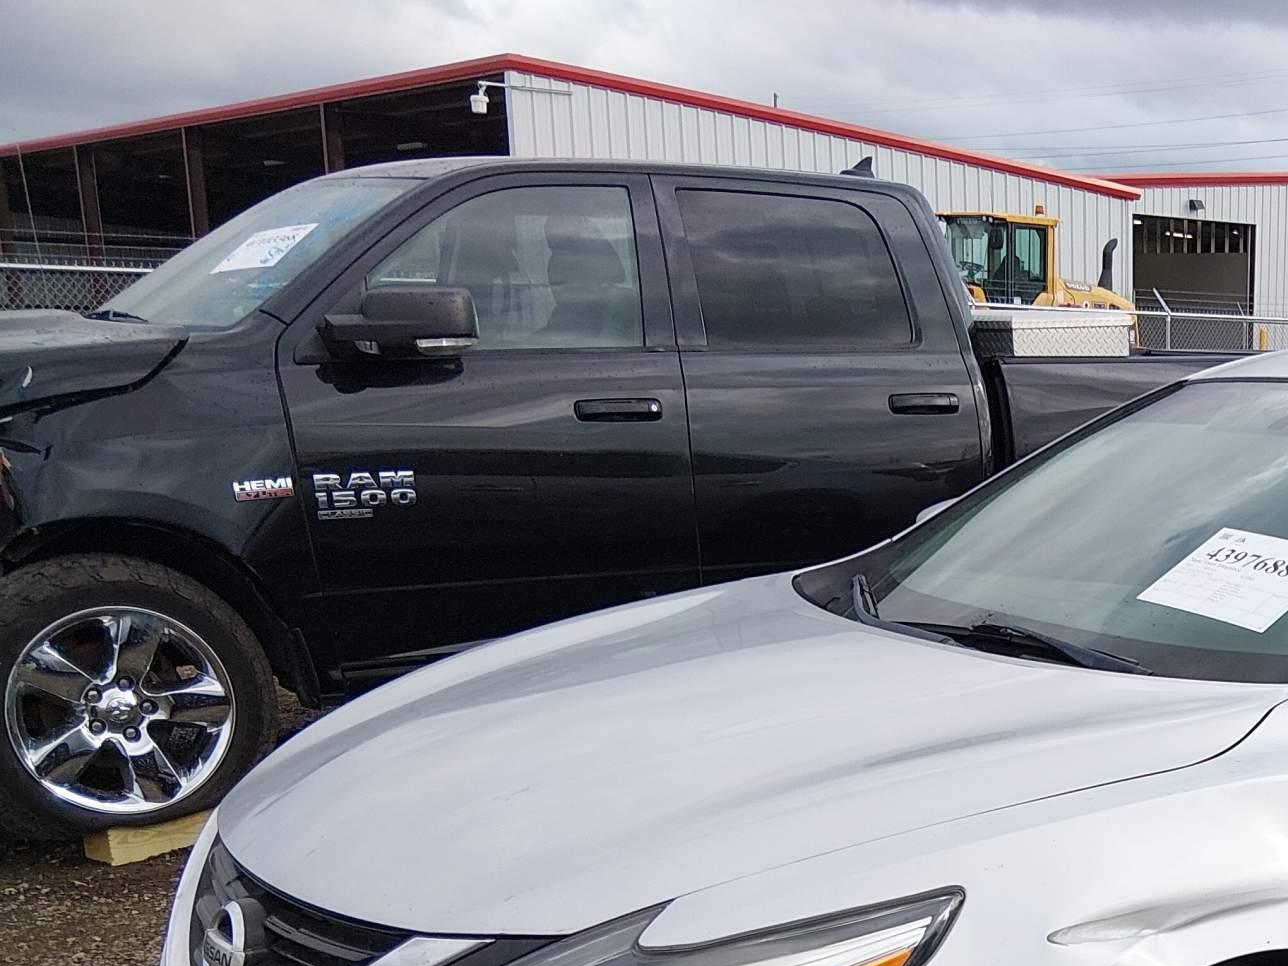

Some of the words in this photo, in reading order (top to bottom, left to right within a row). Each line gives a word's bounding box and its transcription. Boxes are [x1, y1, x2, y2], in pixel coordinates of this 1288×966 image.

[233, 477, 293, 492] HEMI
[313, 470, 416, 489] RAM
[314, 488, 417, 509] 1500
